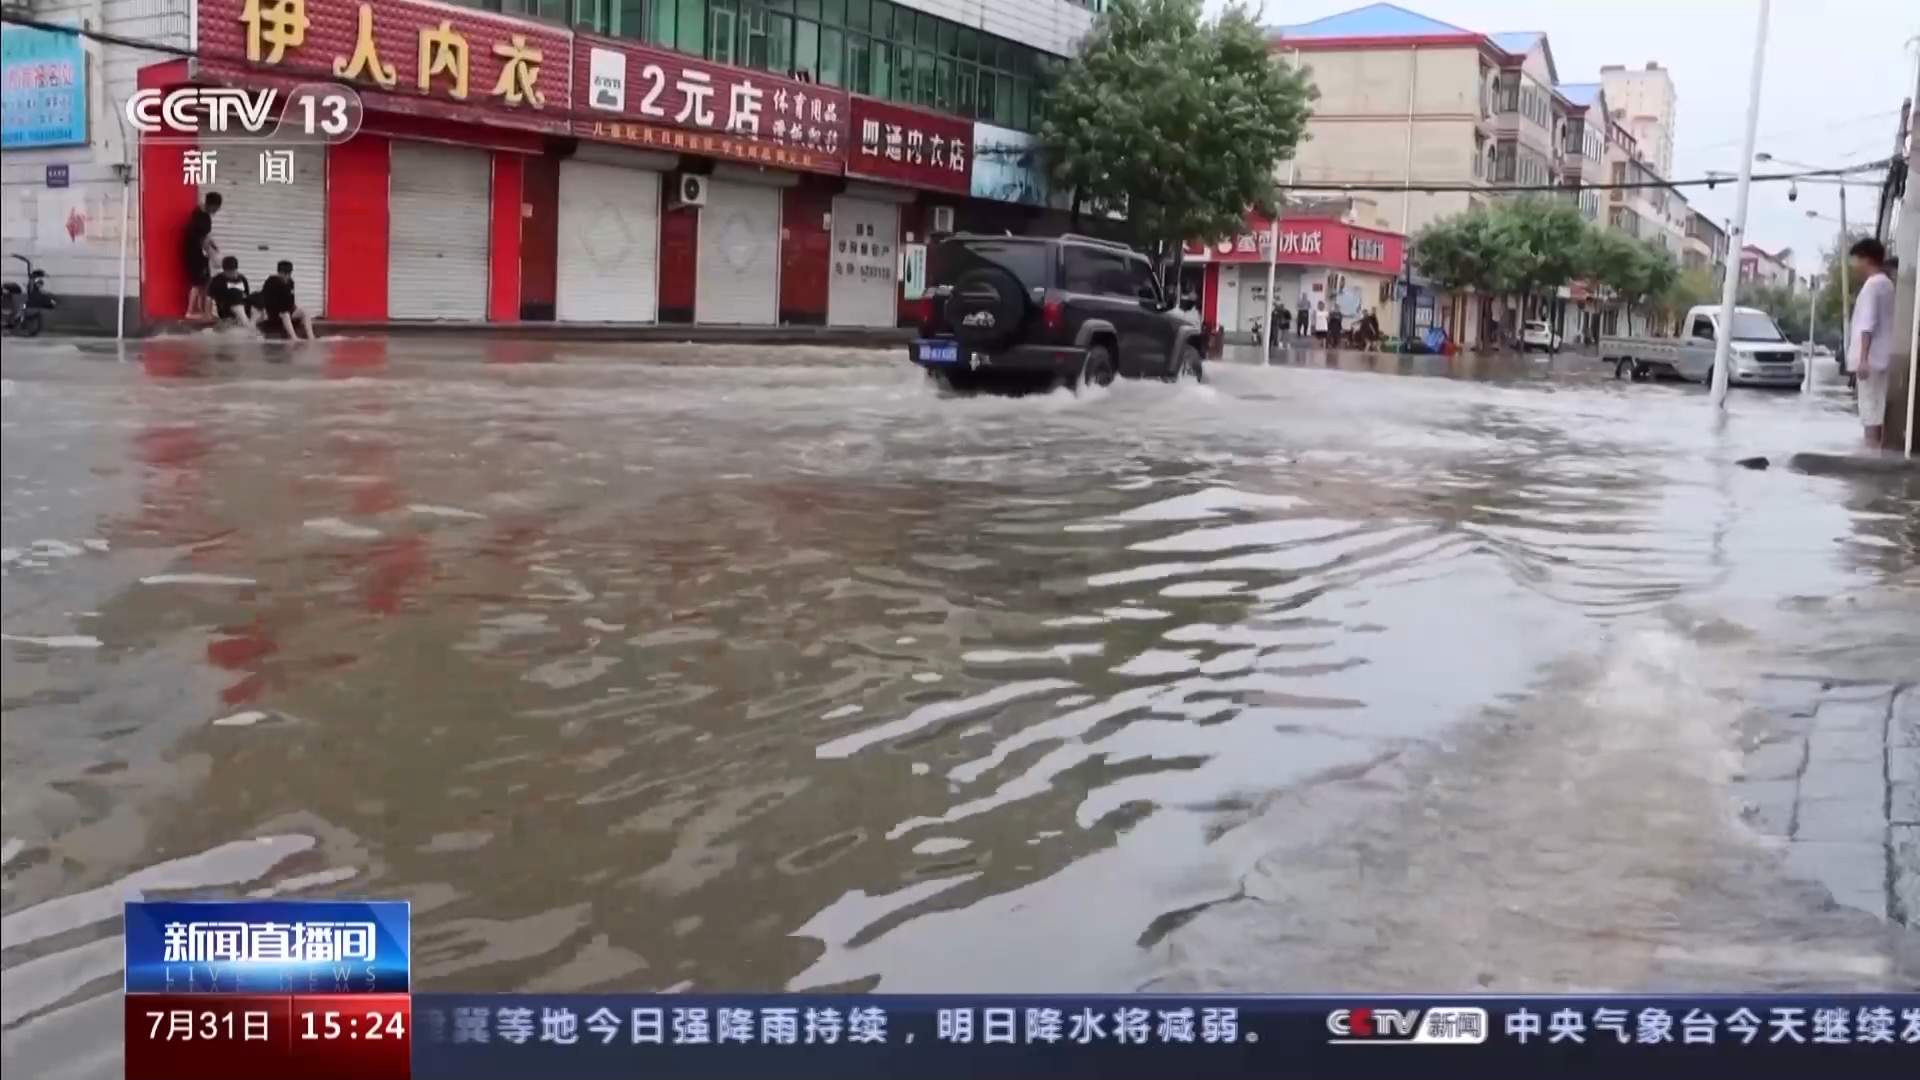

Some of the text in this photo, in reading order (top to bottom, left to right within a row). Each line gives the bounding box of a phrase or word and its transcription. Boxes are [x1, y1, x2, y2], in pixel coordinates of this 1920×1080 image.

[239, 0, 546, 109] 伊人内衣
[640, 65, 763, 141] 2元店
[773, 87, 837, 122] 体育用品
[862, 118, 965, 172] 四通内衣店
